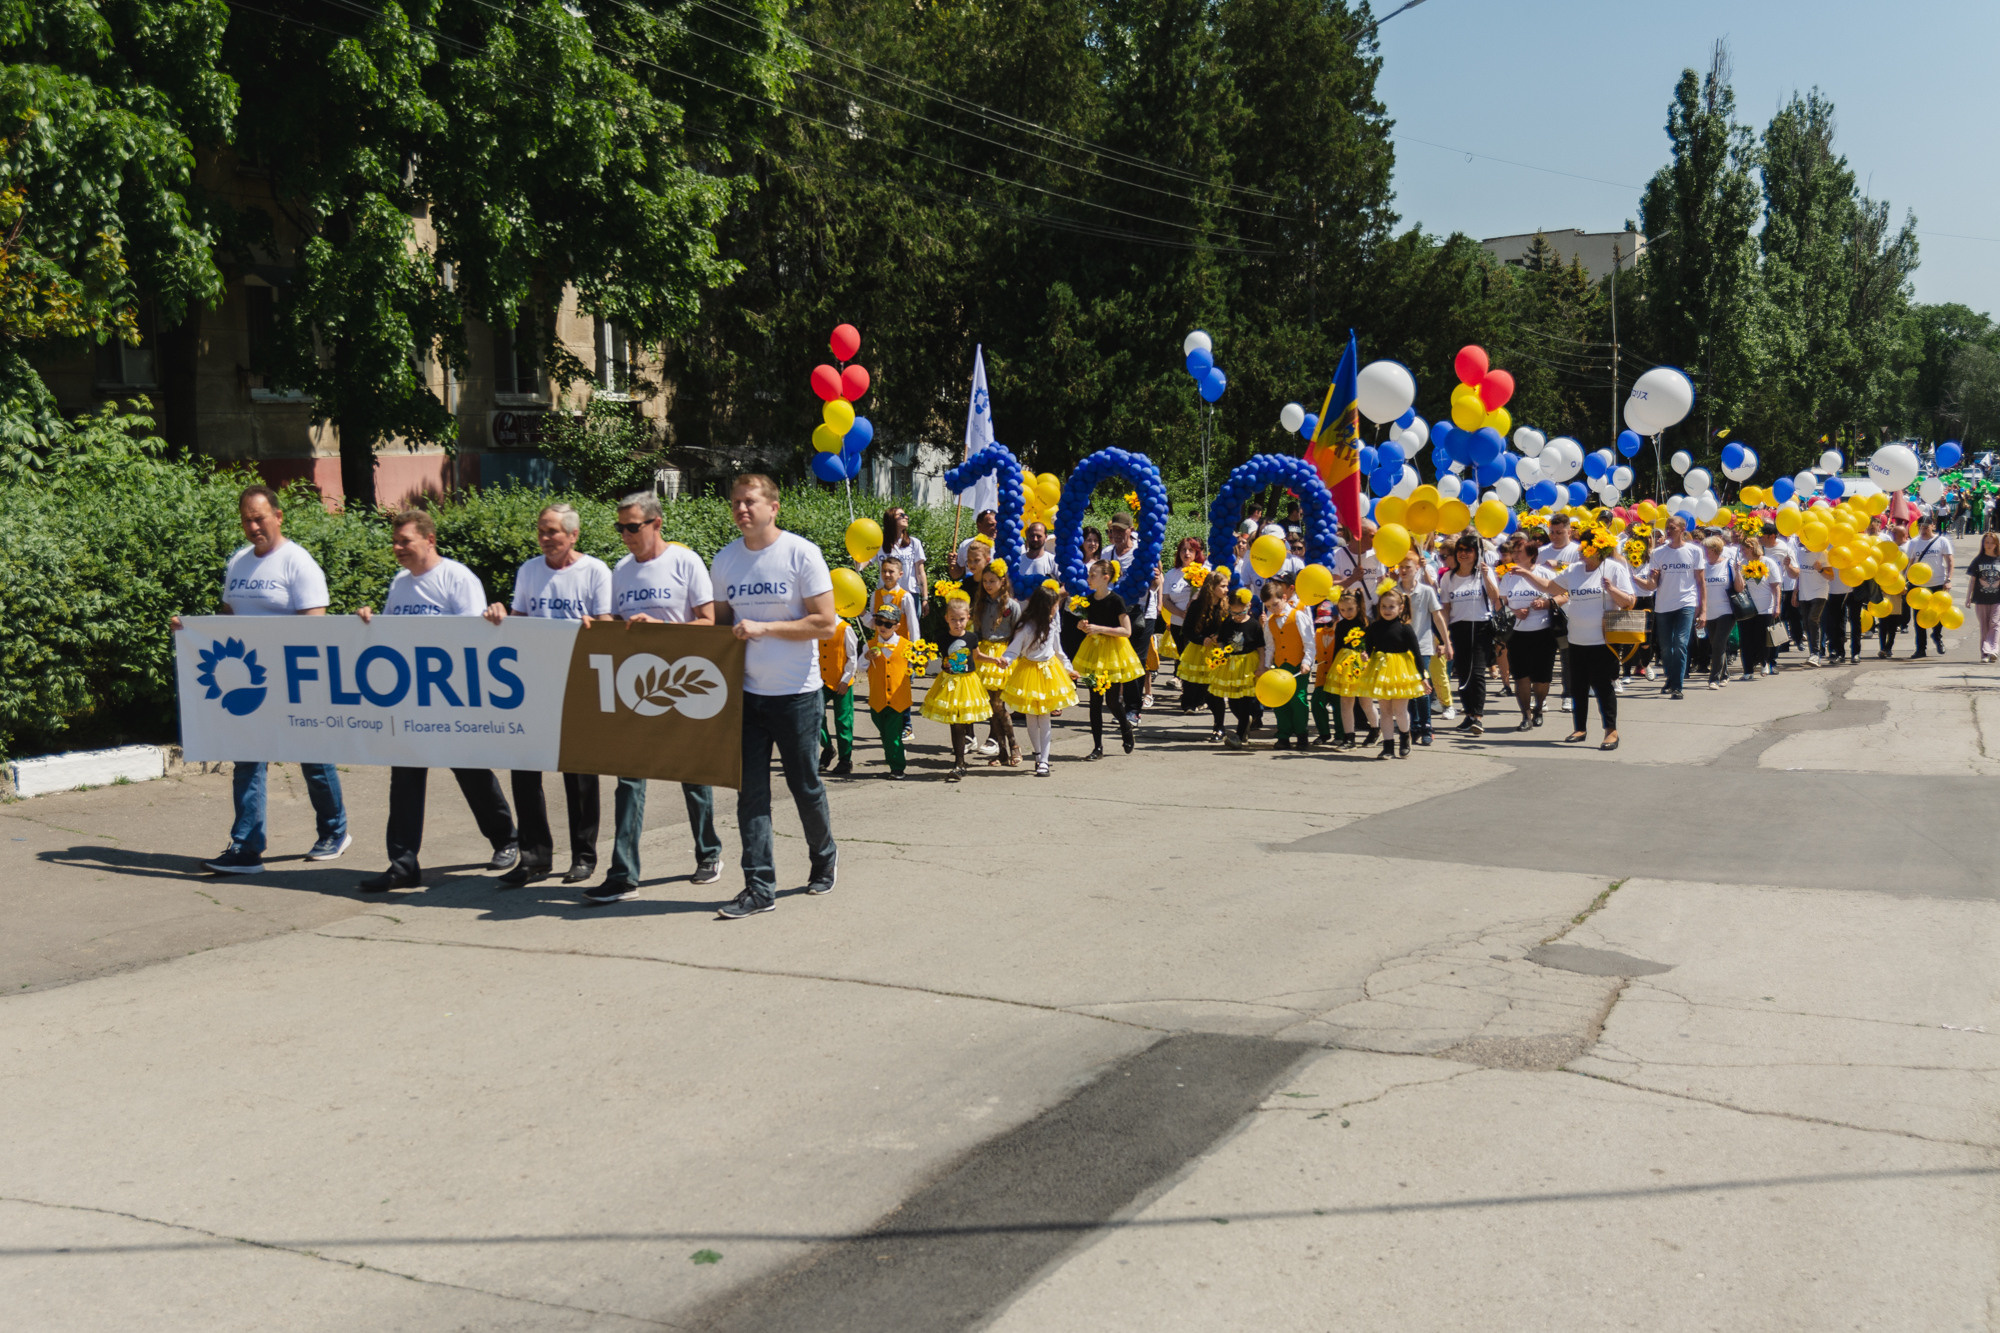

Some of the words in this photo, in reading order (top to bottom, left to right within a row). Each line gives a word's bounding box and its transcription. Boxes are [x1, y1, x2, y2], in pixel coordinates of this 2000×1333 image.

[1632, 389, 1648, 400] ロリス
[237, 579, 277, 590] FLORIS
[739, 582, 787, 596] FLORIS
[627, 588, 671, 602] FLORIS
[1456, 589, 1482, 598] FLORIS
[1571, 587, 1602, 596] FLORIS
[403, 603, 441, 615] FLORIS
[540, 598, 583, 611] FLORIS
[283, 645, 525, 710] FLORIS
[589, 652, 728, 720] 100
[288, 715, 344, 729] Trans-Oil
[347, 716, 383, 733] Group
[404, 720, 451, 733] Floarea
[455, 721, 505, 734] Soarelui
[509, 722, 525, 735] SA
